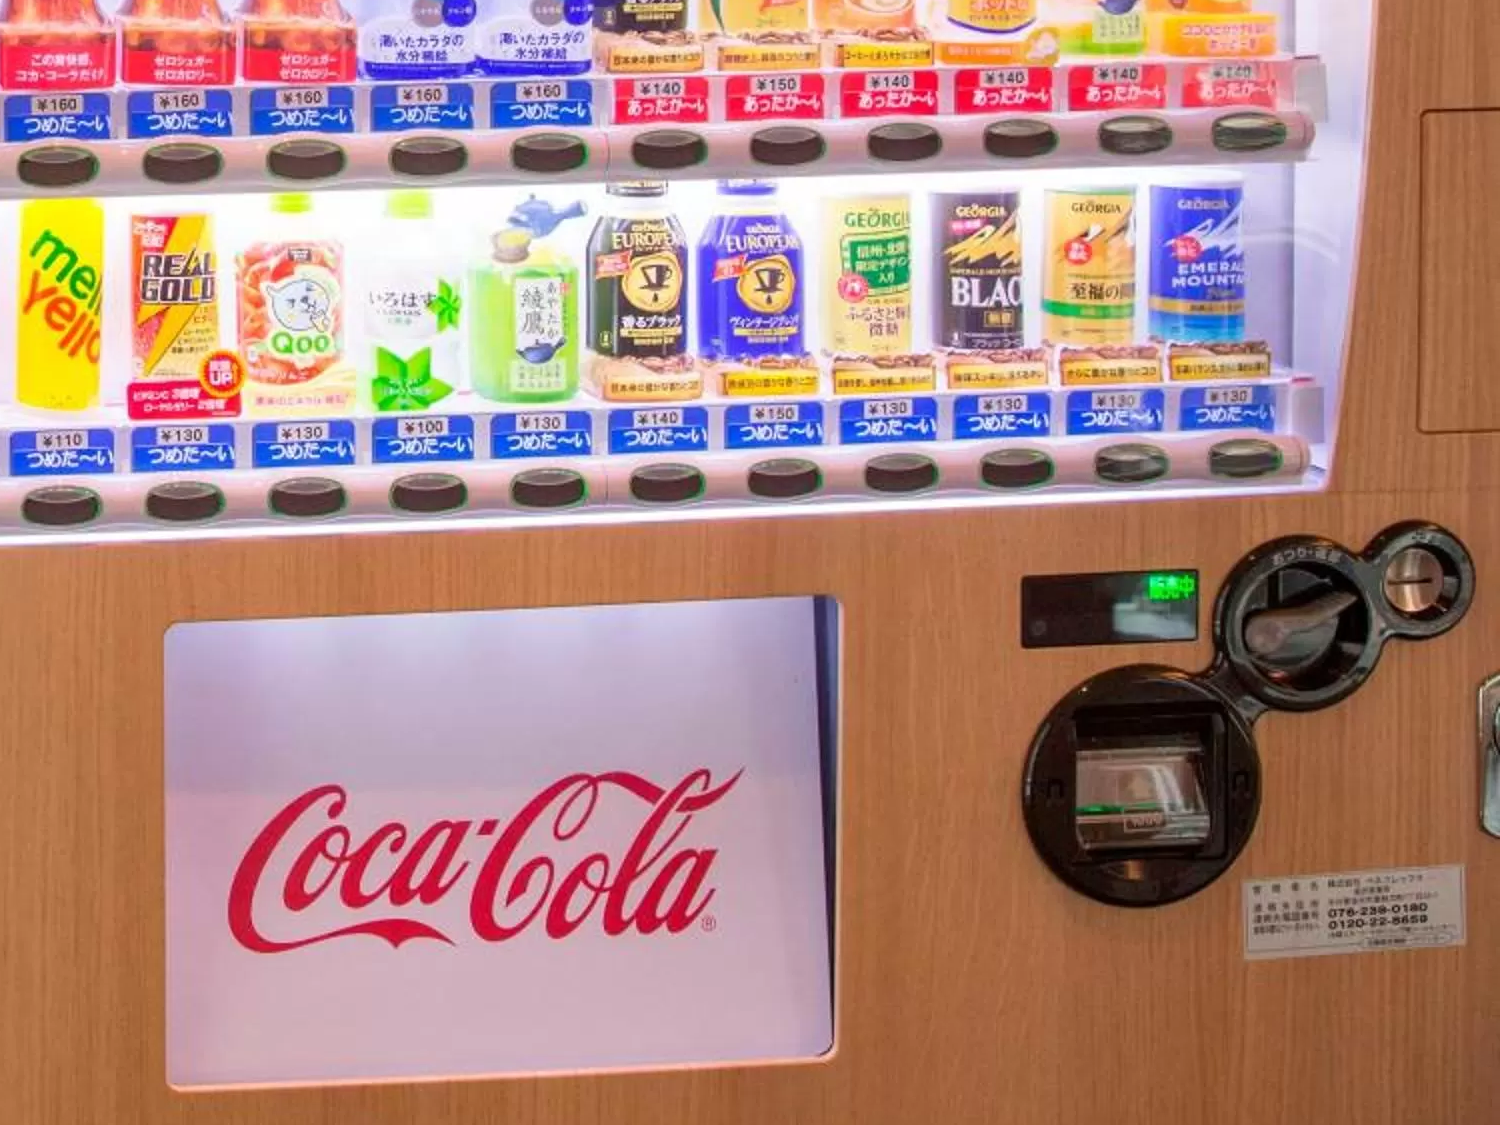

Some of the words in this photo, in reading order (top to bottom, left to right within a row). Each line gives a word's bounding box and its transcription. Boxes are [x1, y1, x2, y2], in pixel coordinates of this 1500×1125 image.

[1071, 199, 1122, 214] GEORGIA
[143, 247, 216, 277] REAL
[1178, 261, 1245, 275] EMERAL
[141, 278, 216, 305] GOLD
[951, 275, 1023, 307] BLAC
[1170, 275, 1245, 289] MOUNTA
[270, 331, 330, 354] Qoo
[227, 766, 745, 954] Coca-Cola
